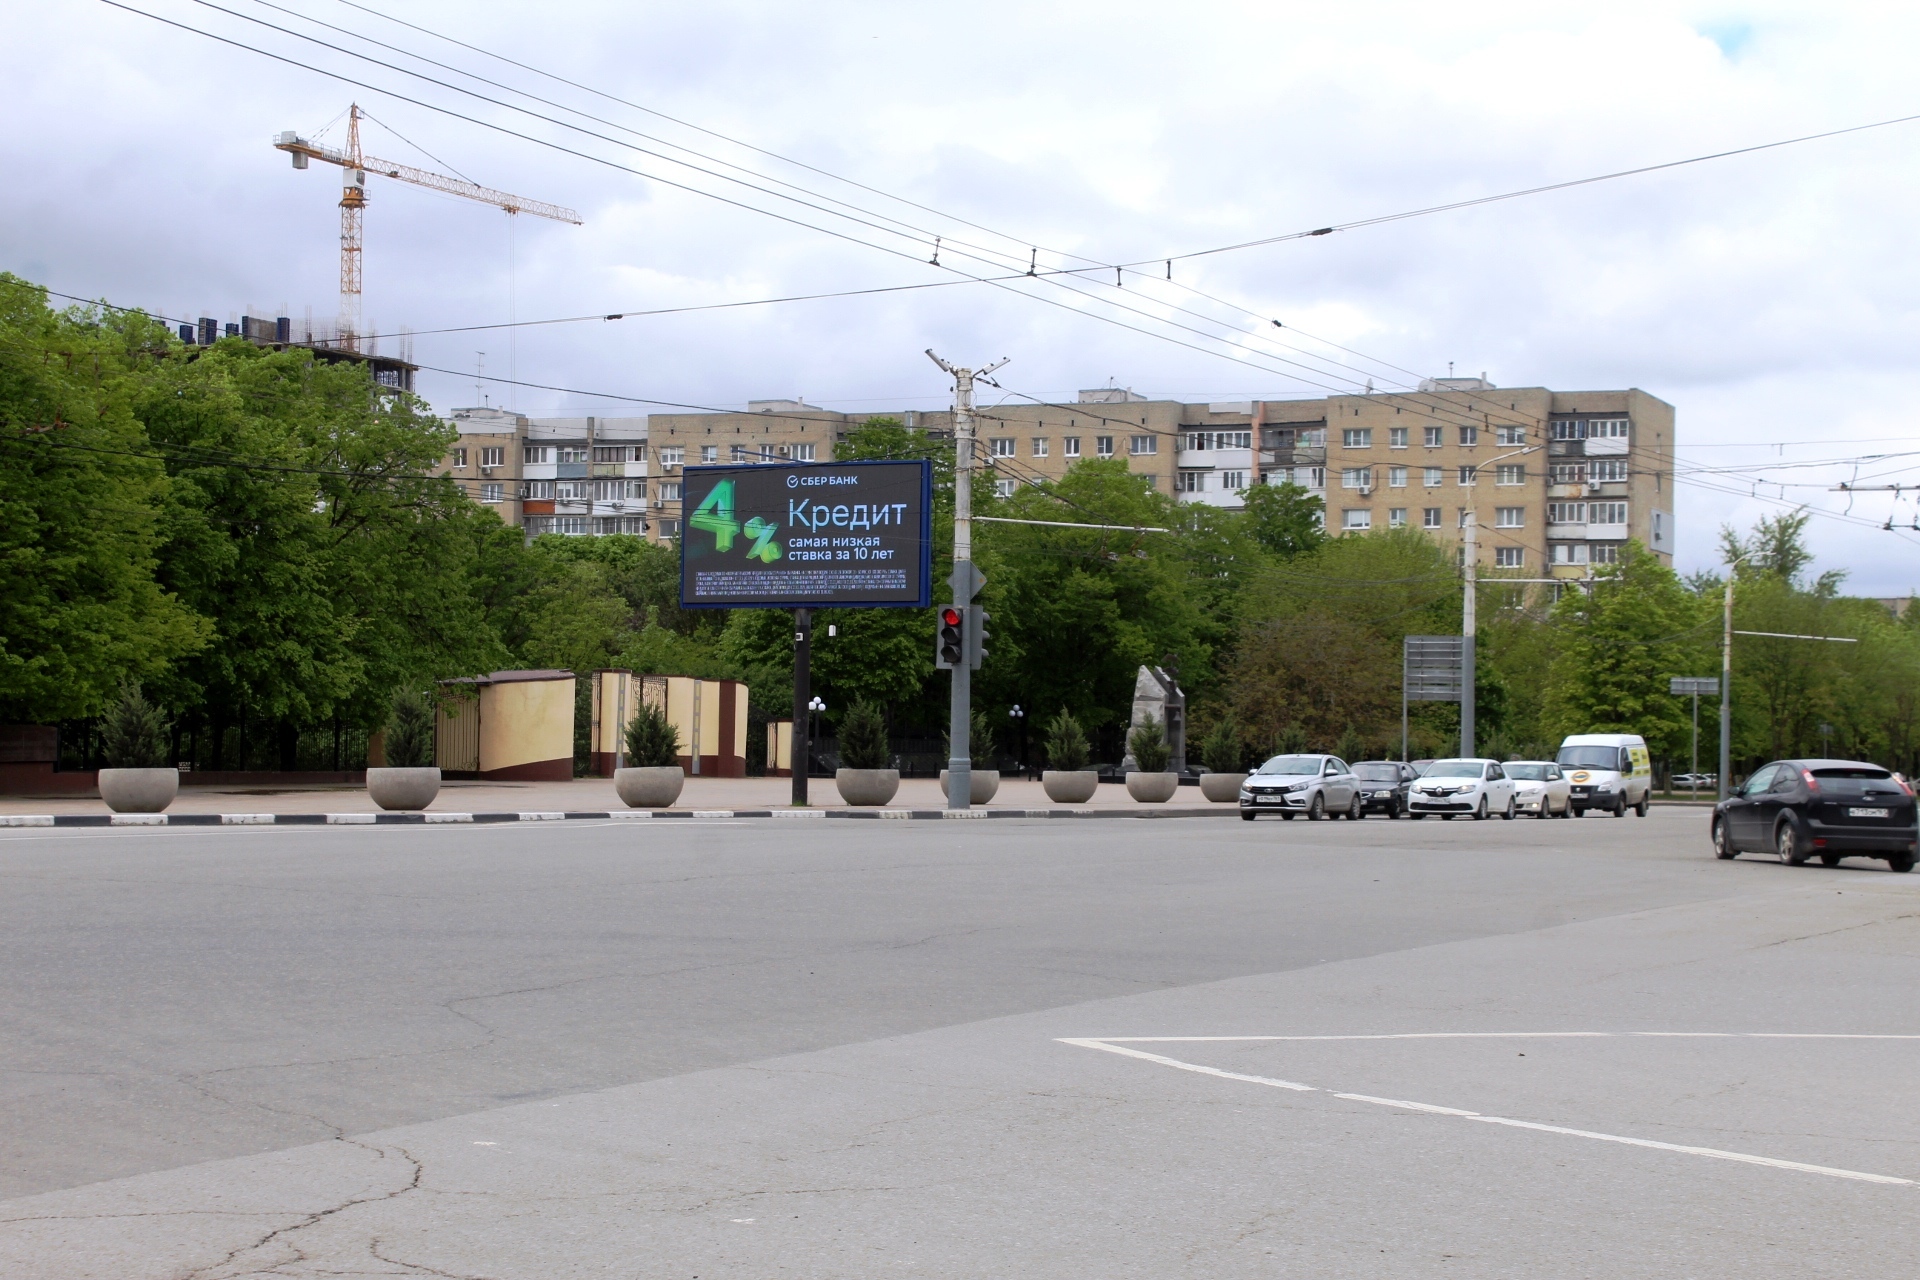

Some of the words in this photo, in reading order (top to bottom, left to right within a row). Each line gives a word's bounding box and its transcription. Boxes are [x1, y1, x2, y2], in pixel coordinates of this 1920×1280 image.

[789, 498, 907, 533] Кредит
[789, 537, 828, 548] самая
[832, 537, 880, 547] низкая
[788, 550, 832, 561] ставка
[836, 550, 850, 560] за
[854, 547, 868, 560] 10
[871, 549, 894, 560] лет
